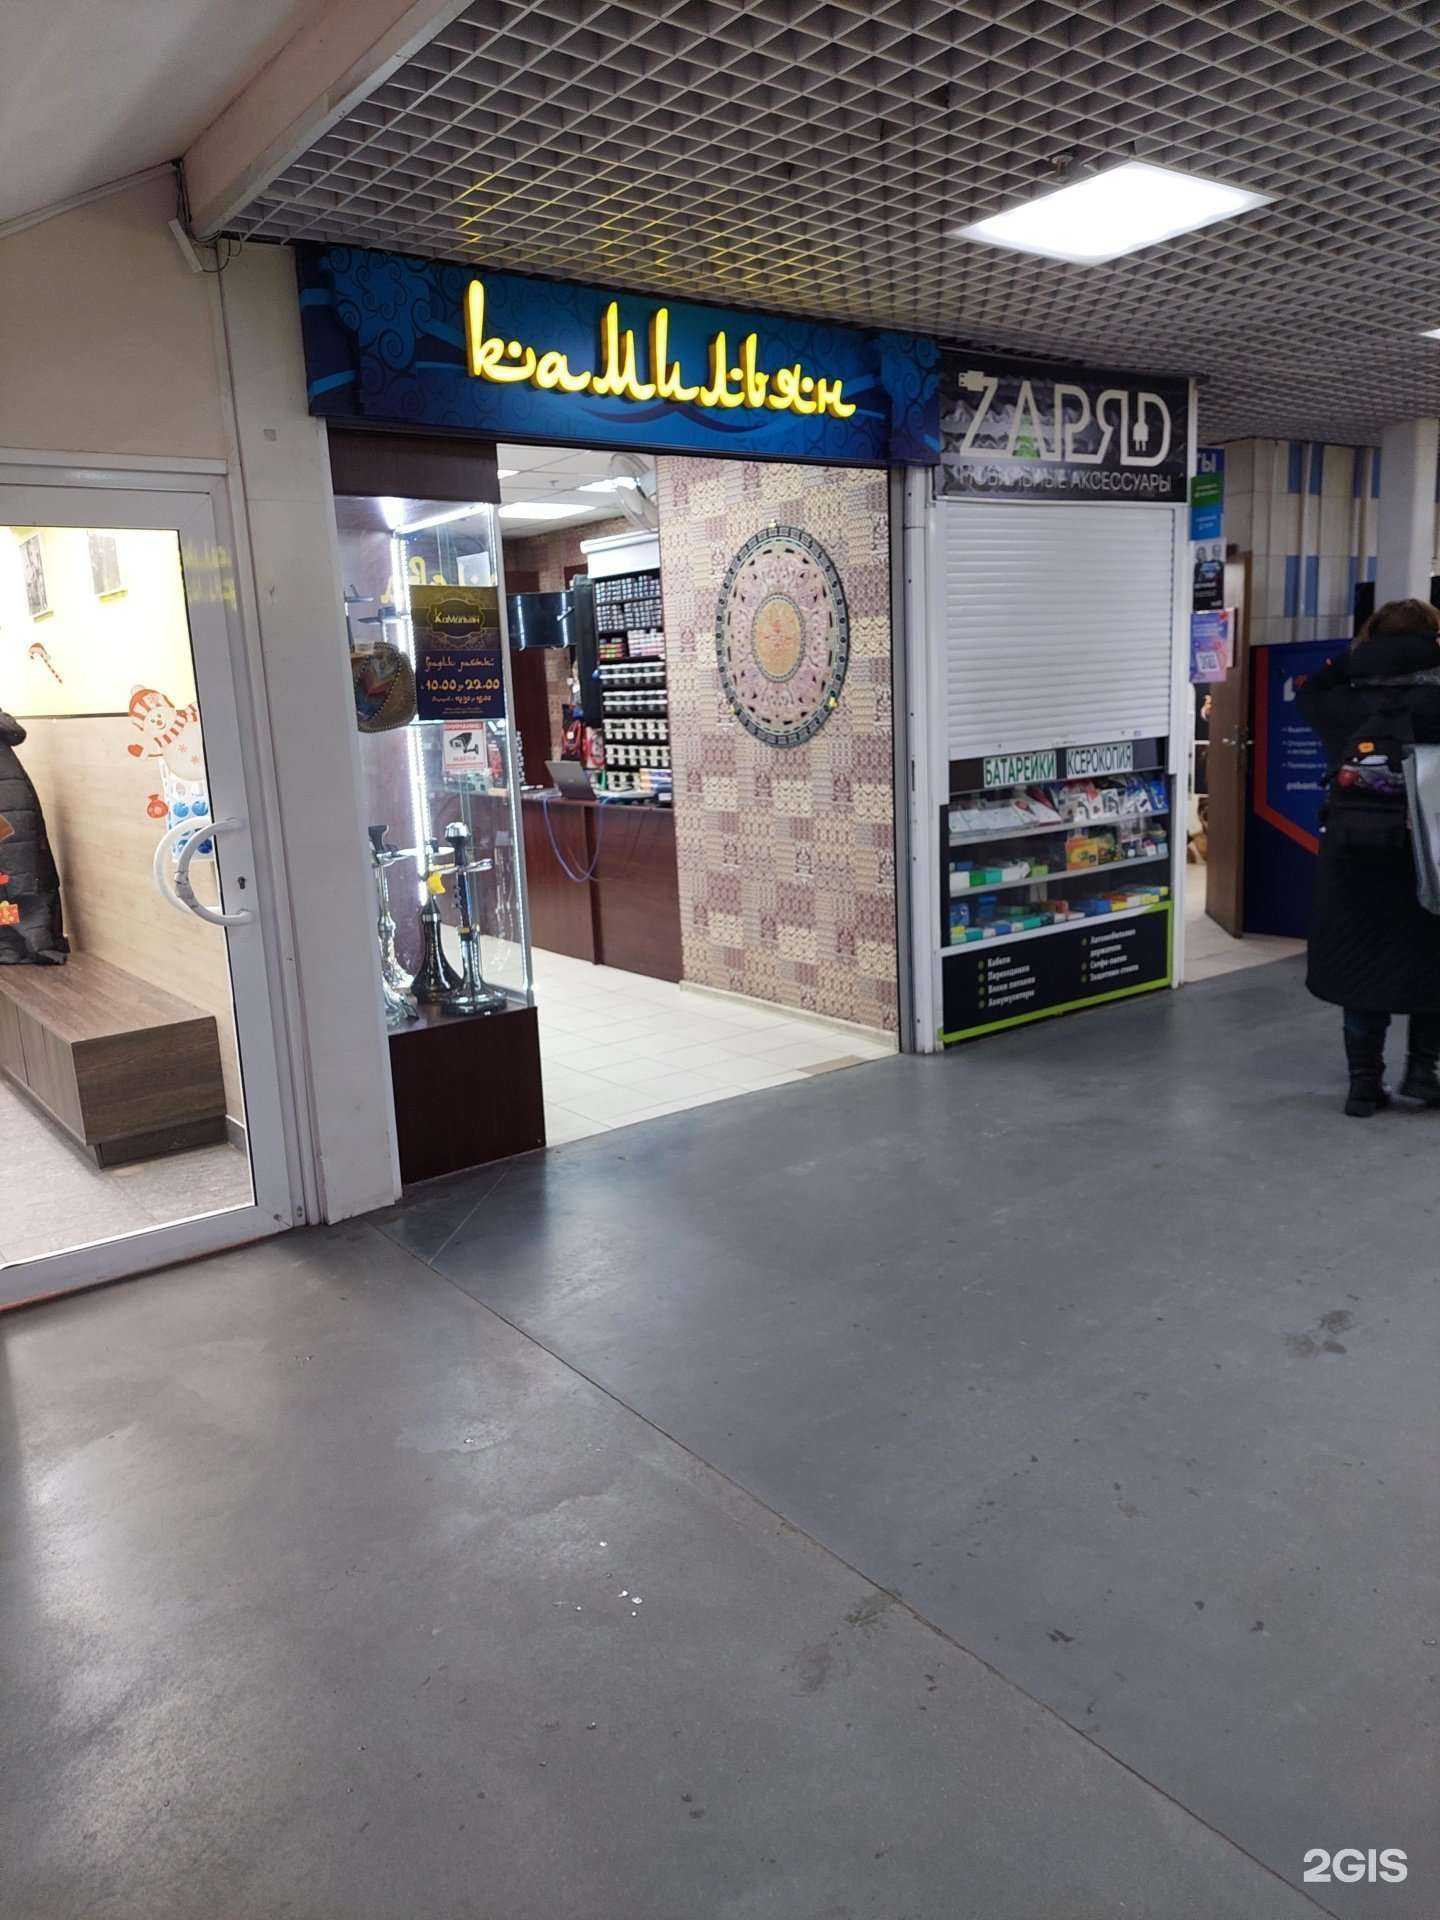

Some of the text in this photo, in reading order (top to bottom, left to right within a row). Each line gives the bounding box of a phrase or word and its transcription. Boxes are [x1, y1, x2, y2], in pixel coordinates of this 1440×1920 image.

[1070, 471, 1172, 493] АКСЕССУАРЫ
[426, 679, 457, 691] 10.00
[465, 678, 500, 690] 22.00
[985, 744, 1132, 785] БАТАРЕЙКИ КСЕРОКОПИЯ
